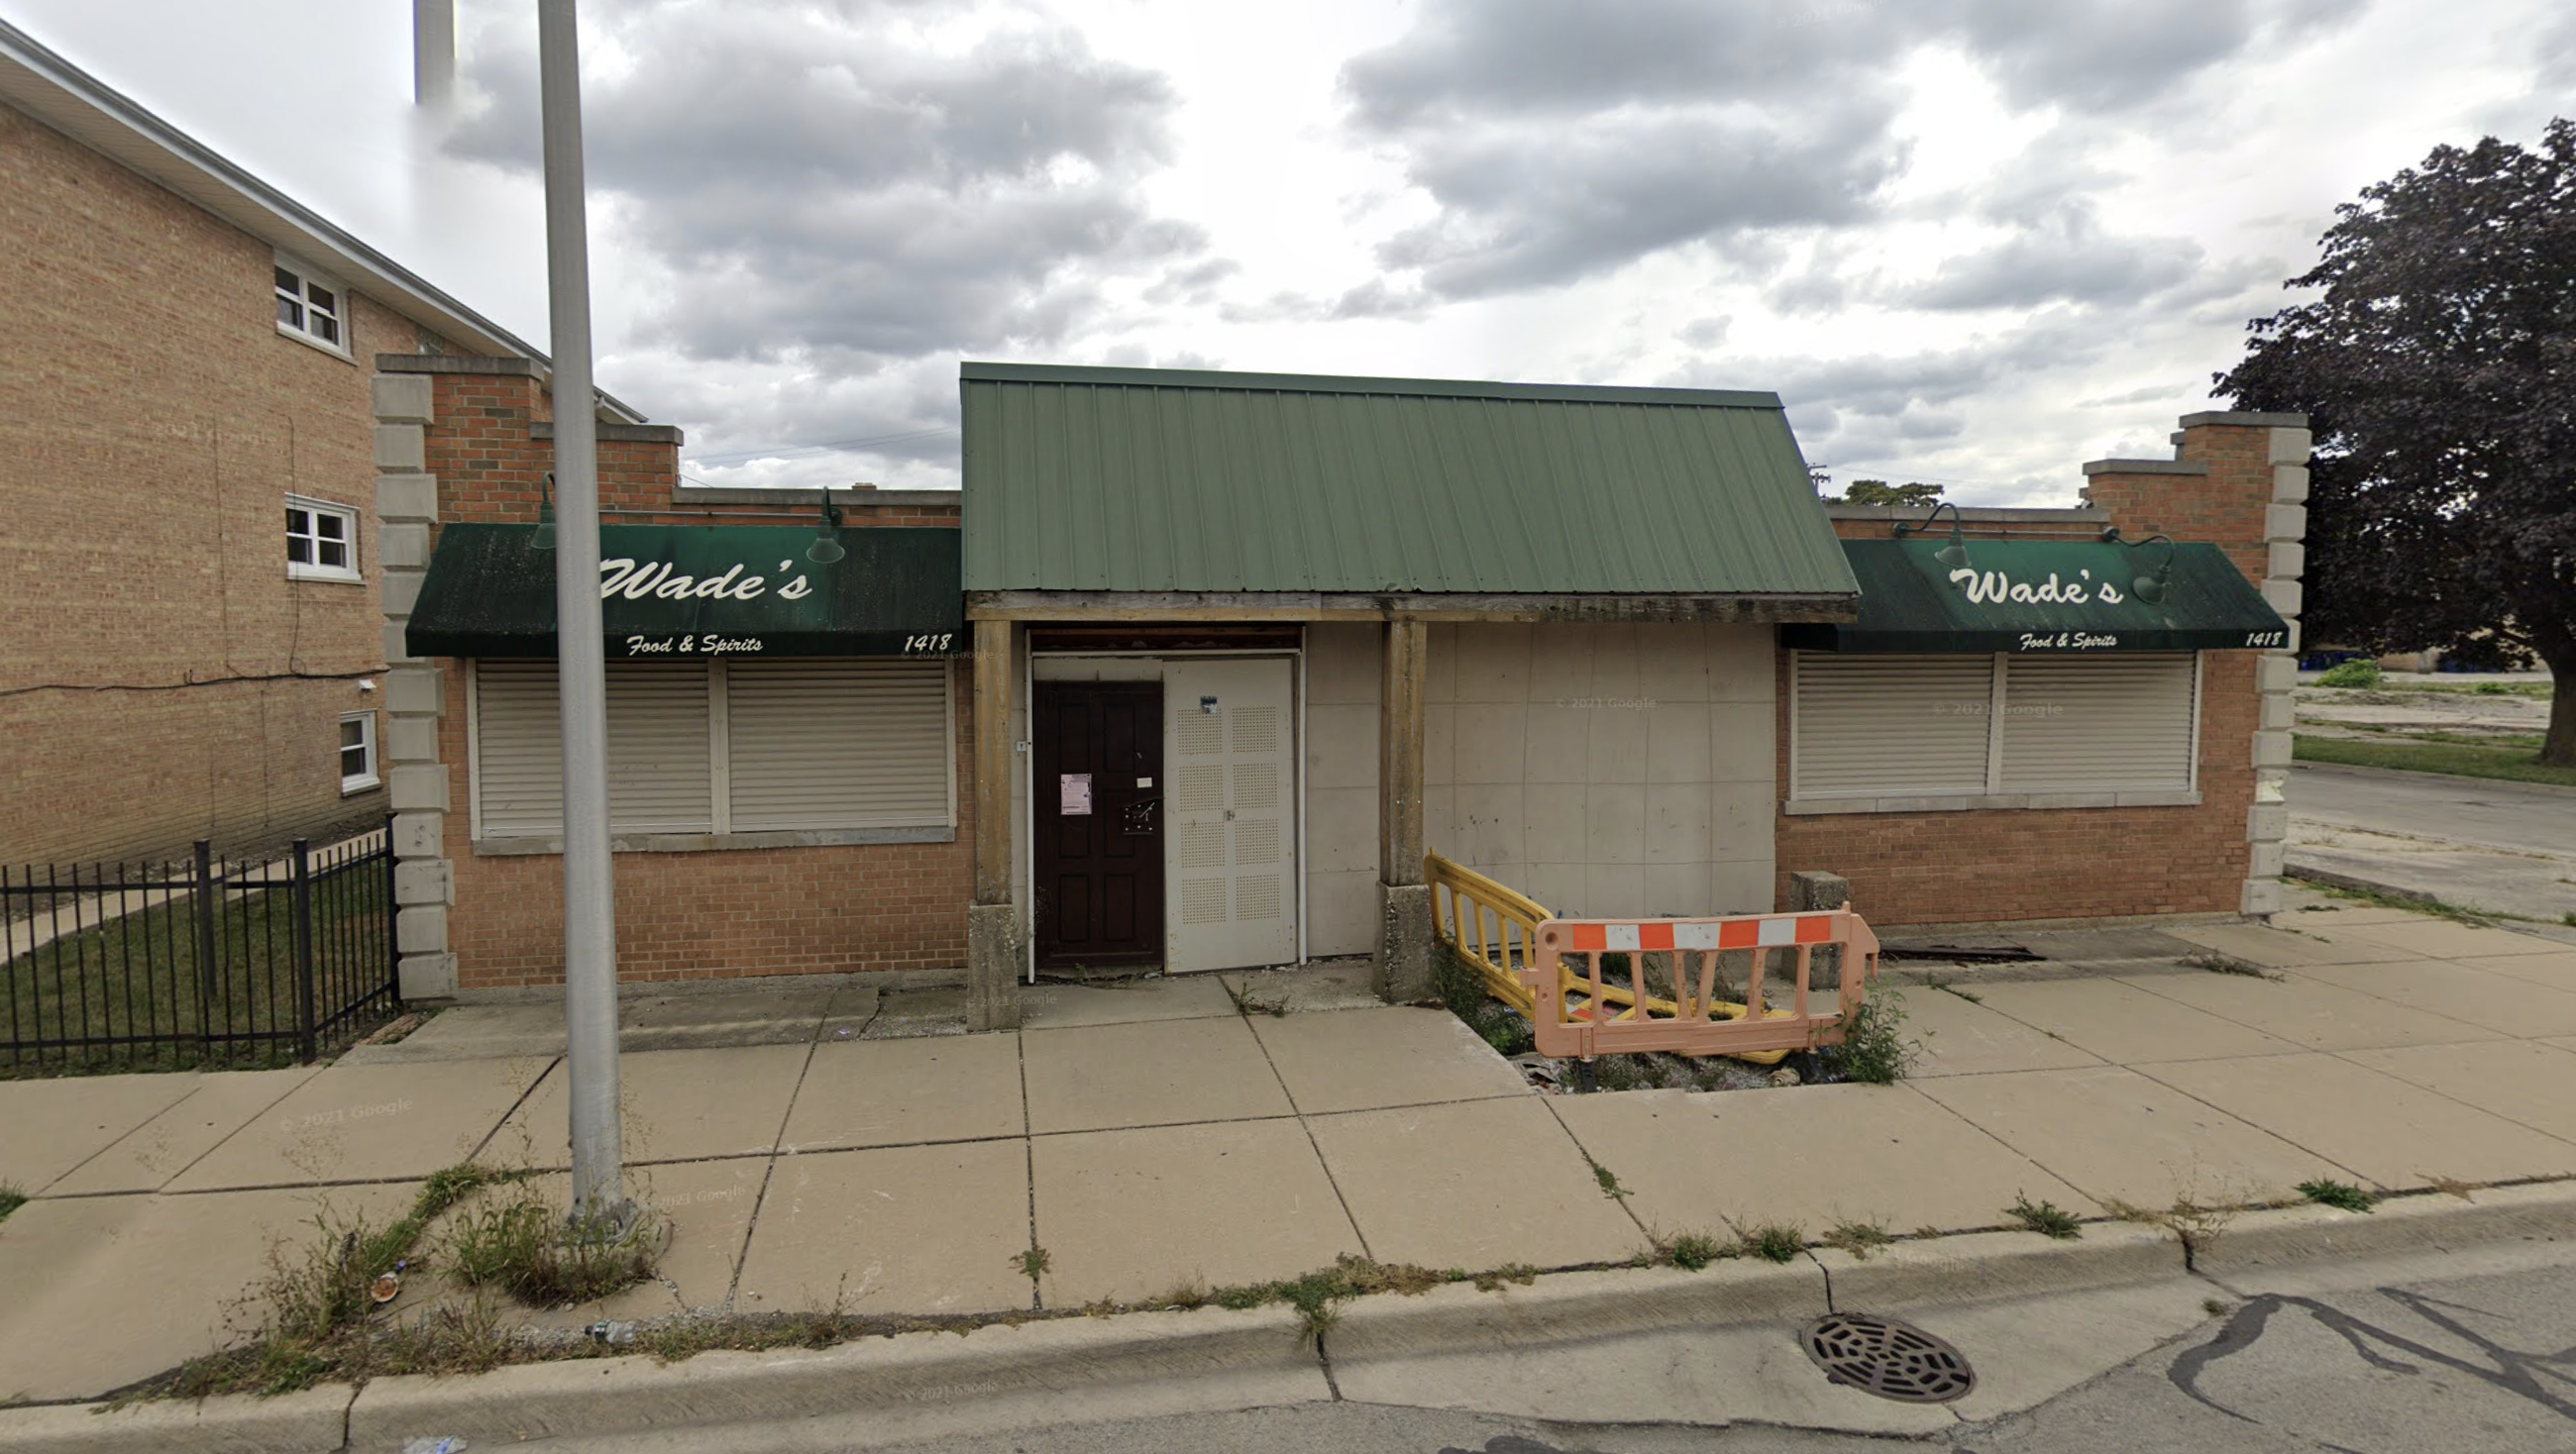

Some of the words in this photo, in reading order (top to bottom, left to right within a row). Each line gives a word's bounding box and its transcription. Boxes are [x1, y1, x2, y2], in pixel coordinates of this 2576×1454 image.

[599, 558, 814, 600] Wade's
[1949, 568, 2124, 605] Wade's
[626, 635, 674, 656] Food
[679, 634, 694, 653] &
[699, 634, 763, 656] Spirits
[905, 633, 953, 652] 1418
[2019, 633, 2054, 651] Food
[2056, 632, 2069, 648] &
[2072, 632, 2118, 650] Spirits
[2246, 632, 2283, 646] 1418
